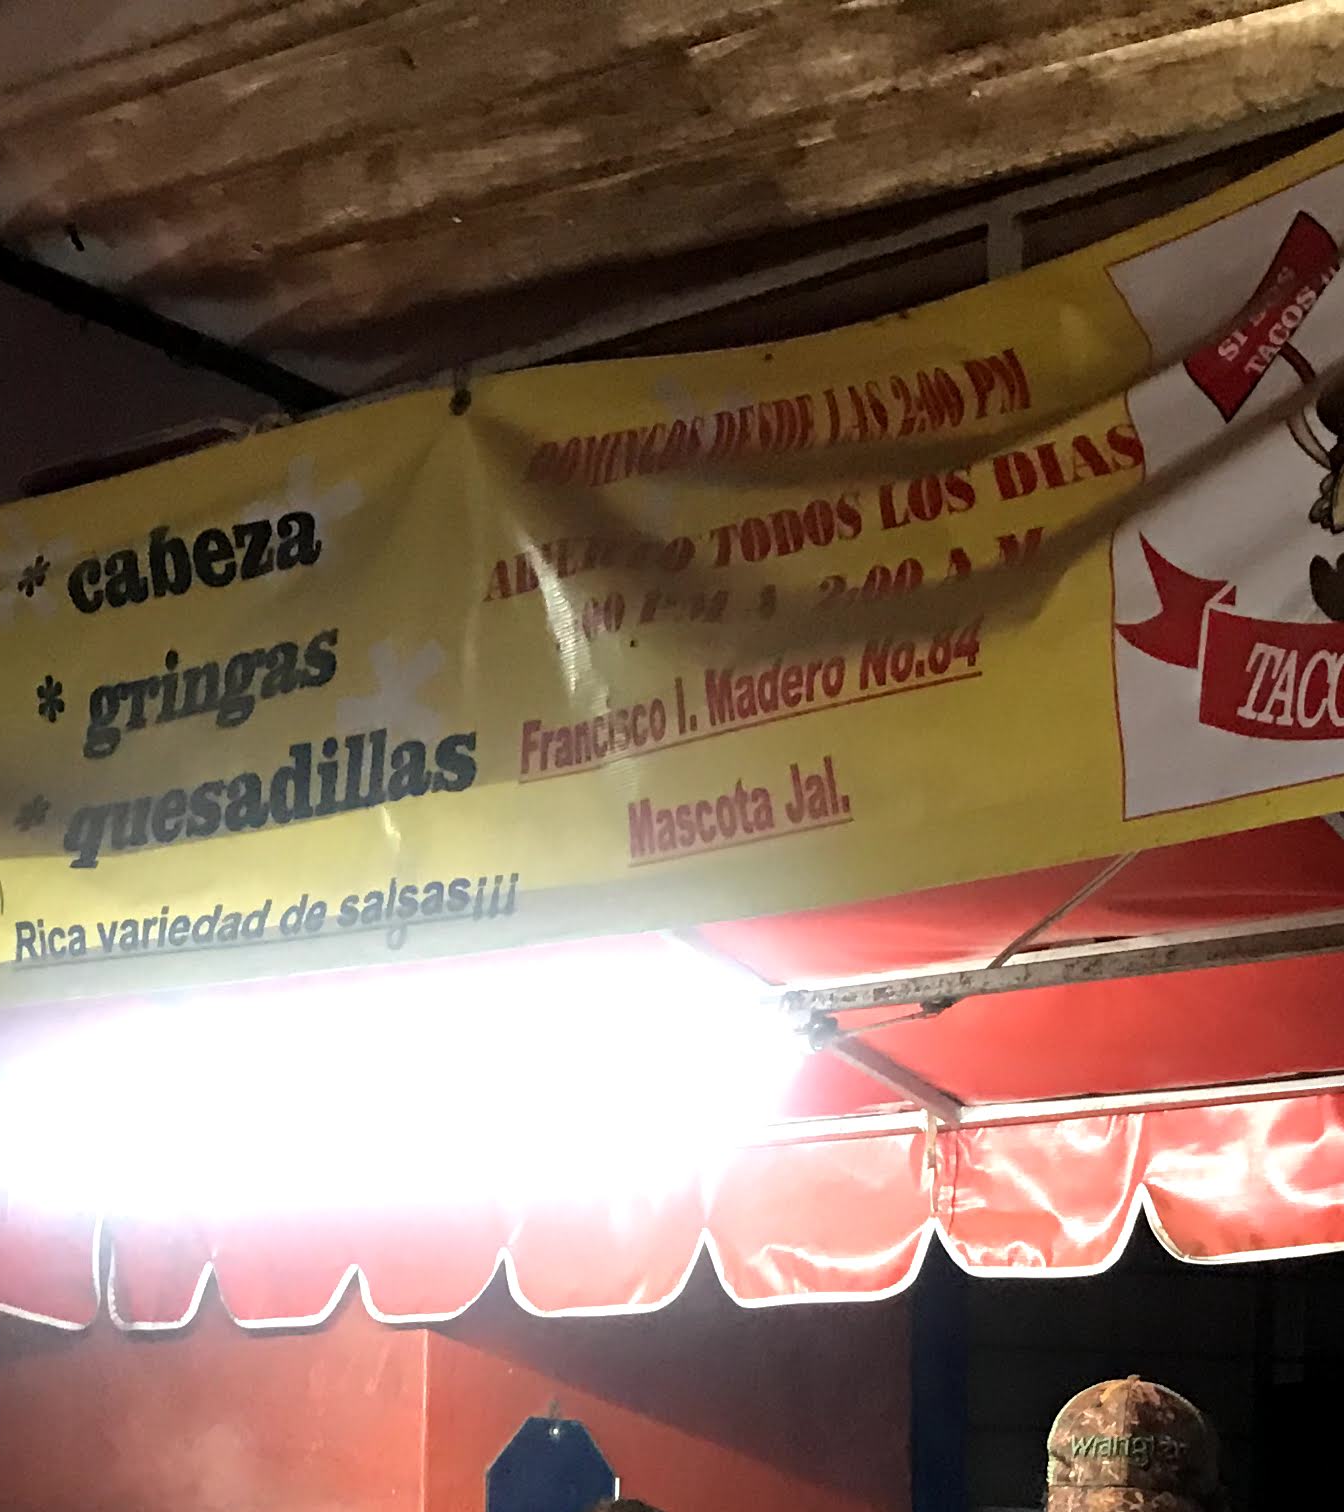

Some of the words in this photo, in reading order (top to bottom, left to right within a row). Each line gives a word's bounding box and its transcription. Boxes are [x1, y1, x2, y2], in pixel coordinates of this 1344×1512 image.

[1217, 329, 1249, 362] SI
[1243, 284, 1317, 375] TACOS
[704, 394, 815, 456] DESDE
[963, 347, 1032, 420] PM
[707, 491, 863, 569] TODOS
[878, 462, 977, 531] LOS
[993, 423, 1146, 502] DIAS
[67, 509, 323, 615] cabeza
[82, 627, 340, 760] gringas
[518, 697, 667, 776] Francisco
[705, 654, 846, 729] Madero
[62, 727, 479, 869] quesadillas
[627, 777, 776, 860] Mascota
[784, 754, 852, 826] Jal.
[14, 918, 88, 964] Rica
[96, 898, 273, 955] variedad
[279, 892, 327, 937] de
